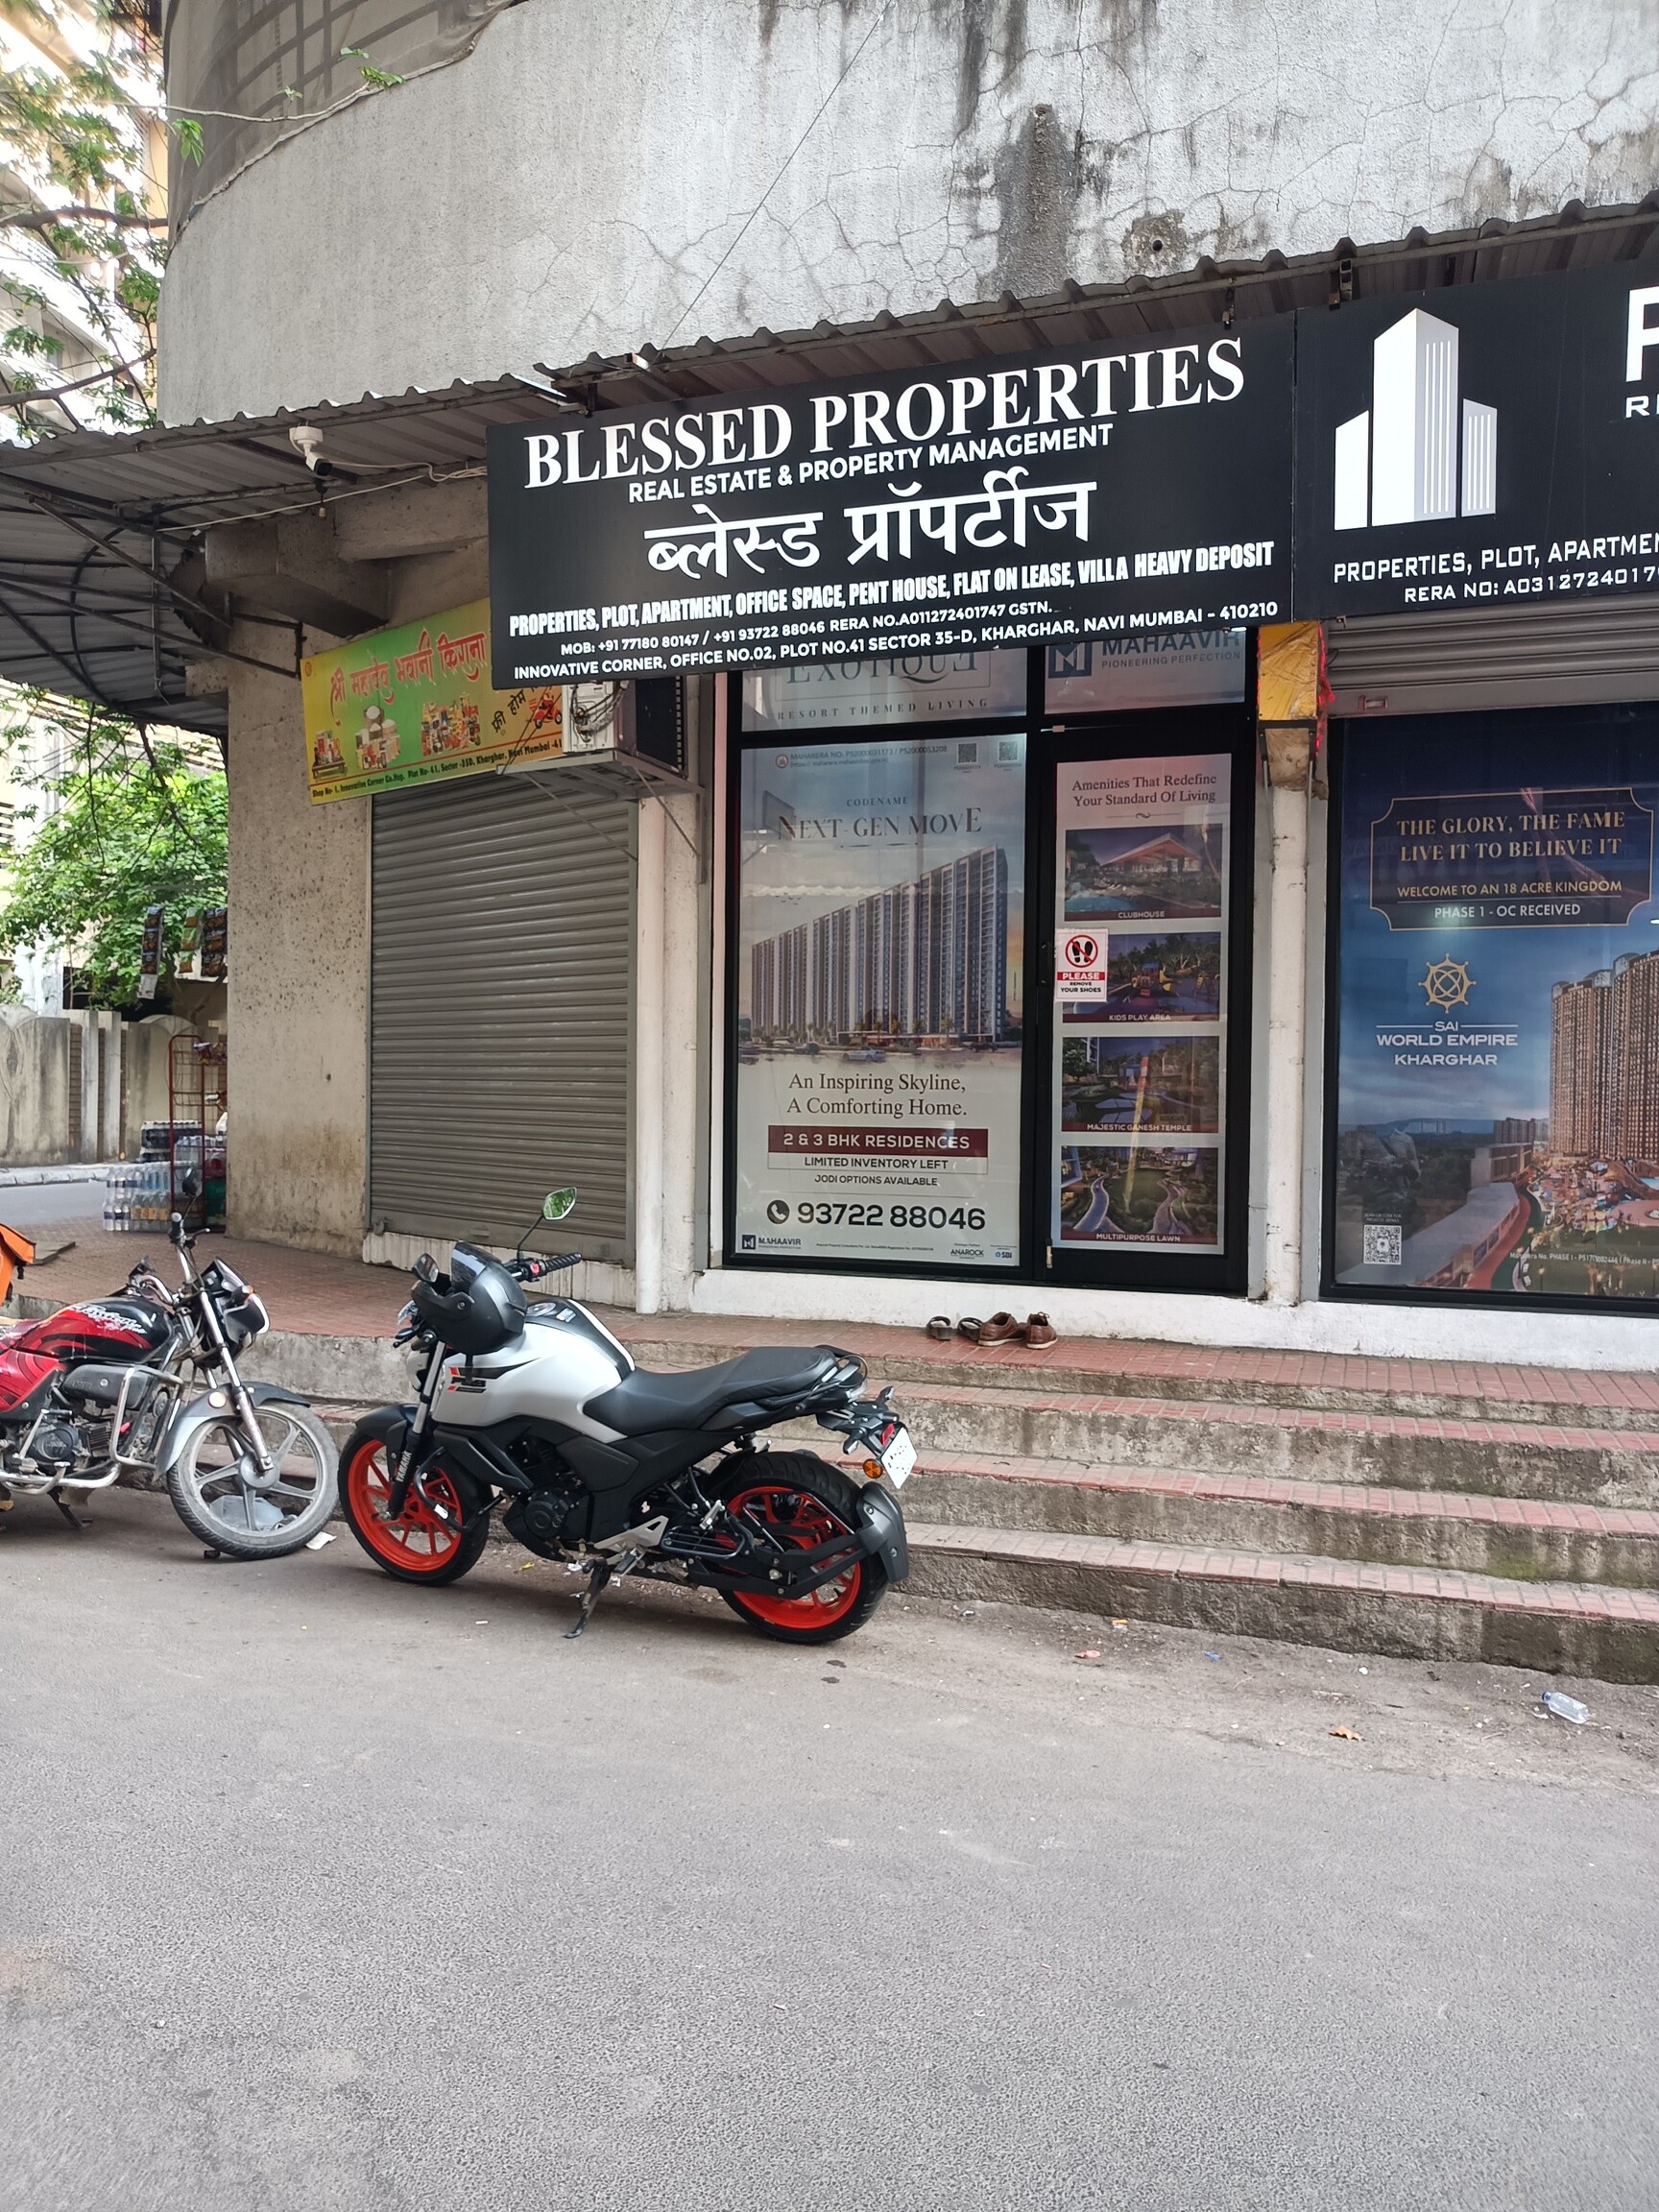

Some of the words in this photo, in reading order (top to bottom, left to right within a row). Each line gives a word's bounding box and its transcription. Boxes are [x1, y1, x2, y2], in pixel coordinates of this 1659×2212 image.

[524, 403, 792, 489] BLESSED
[809, 336, 1245, 453] PROPERTIES
[629, 478, 685, 503] REAL
[690, 468, 772, 496] ESTATE
[778, 465, 793, 486] &
[799, 446, 923, 484] PROPERTY
[928, 423, 1114, 467] MANAGEMENT
[643, 503, 824, 580] ब्लेस्ड
[843, 466, 1097, 565] प्रॉपर्टीज
[1334, 552, 1473, 584] PROPERTIES,
[1480, 544, 1540, 569] PLOT,
[509, 608, 600, 637] PROPERTIES,
[601, 603, 640, 629] PLOT,
[641, 593, 733, 624] APARTMENT,
[735, 589, 788, 615] OFFICE
[791, 584, 847, 611] SPACE,
[849, 580, 890, 607] PENT
[892, 574, 951, 603] HOUSE,
[952, 569, 992, 596] FLAT
[993, 565, 1018, 592] ON
[1021, 561, 1075, 590] LEASE,
[1077, 556, 1129, 585] VILLA
[1134, 548, 1192, 578] HEAVY
[1195, 541, 1275, 573] DEPOSIT
[1405, 584, 1456, 603] RERA
[1463, 581, 1499, 598] NO:
[1503, 565, 1659, 595] A0312724017
[561, 642, 595, 656] MOB:
[597, 638, 619, 652] +91
[621, 636, 659, 651] 77180
[661, 633, 700, 648] 80147
[702, 630, 710, 645] /
[713, 629, 735, 643] +91
[738, 625, 779, 641] 93722
[781, 620, 826, 637] 88046
[830, 616, 868, 633] RERA
[872, 604, 1006, 629] NO.A011272401747
[1008, 600, 1053, 616] GSTN.
[514, 661, 599, 680] INNOVATIVE
[602, 656, 667, 673] CORNER,
[670, 650, 723, 667] OFFICE
[727, 645, 777, 662] NO.02,
[780, 642, 818, 659] PLOT
[822, 638, 864, 656] NO.41
[868, 634, 930, 651] SECTOR
[934, 630, 977, 646] 35-D,
[981, 619, 1079, 642] KHARGHAR,
[1084, 615, 1124, 633] NAVI
[1129, 609, 1202, 629] MUMBAI
[1219, 601, 1278, 620] 410210
[1101, 657, 1167, 669] PIONEERING
[1170, 652, 1240, 664] PERFECTION
[508, 689, 526, 715] होम
[778, 708, 839, 720] RESORT
[849, 703, 917, 716] THEMED
[927, 699, 988, 711] LIVING
[1071, 779, 1130, 791] Amenities
[1133, 776, 1160, 788] That
[1164, 774, 1216, 786] Redefine
[847, 797, 908, 807] CODENAME
[1073, 795, 1102, 806] Your
[1105, 791, 1157, 805] Standard
[1160, 790, 1176, 803] Of
[1179, 789, 1215, 803] Living
[908, 807, 982, 835] MOVE
[1397, 820, 1436, 836] THE
[1442, 816, 1513, 834] GLORY,
[1519, 814, 1560, 830] THE
[1567, 811, 1625, 829] FAME
[1401, 845, 1444, 862] LIVE
[1450, 844, 1470, 860] IT
[1475, 842, 1503, 858] TO
[1509, 839, 1593, 858] BELIEVE
[1599, 838, 1623, 855] IT
[1397, 885, 1457, 898] WELCOME
[1461, 885, 1477, 895] TO
[1479, 883, 1500, 895] AN
[1503, 883, 1517, 894] 18
[1521, 882, 1551, 893] ACRE
[1555, 880, 1623, 893] KINGDOM
[1118, 910, 1165, 919] CLUBHOUSE
[1434, 906, 1475, 919] PHASE
[1479, 906, 1484, 917] 1
[1496, 905, 1516, 917] OC
[1520, 903, 1581, 916] RECEIVED
[1062, 972, 1099, 980] PLEASE
[1434, 1022, 1458, 1032] SAI
[1376, 1034, 1442, 1046] WORLD
[1447, 1034, 1518, 1046] EMPIRE
[1394, 1053, 1498, 1066] KHARGHAR
[788, 1072, 813, 1090] An
[819, 1073, 894, 1094] Inspiring
[899, 1073, 966, 1094] Skyline,
[786, 1097, 803, 1114] A
[806, 1097, 903, 1119] Comforting
[908, 1098, 967, 1116] Home.
[783, 1133, 793, 1145] 2
[798, 1134, 808, 1145] &
[812, 1134, 823, 1145] 3
[828, 1135, 860, 1146] BHK
[865, 1135, 970, 1149] RESIDENCES
[805, 1157, 849, 1167] LIMITED
[851, 1158, 919, 1169] INVENTORY
[920, 1159, 949, 1169] LEFT
[814, 1174, 837, 1184] JODI
[839, 1176, 882, 1185] OPTIONS
[883, 1177, 937, 1186] AVAILABLE
[798, 1202, 883, 1226] 93722
[890, 1205, 986, 1230] 88046
[758, 1237, 801, 1245] MAHAAVIR
[1095, 1233, 1155, 1242] MULTIPURPOSE
[396, 1451, 413, 1482] YAMAHA
